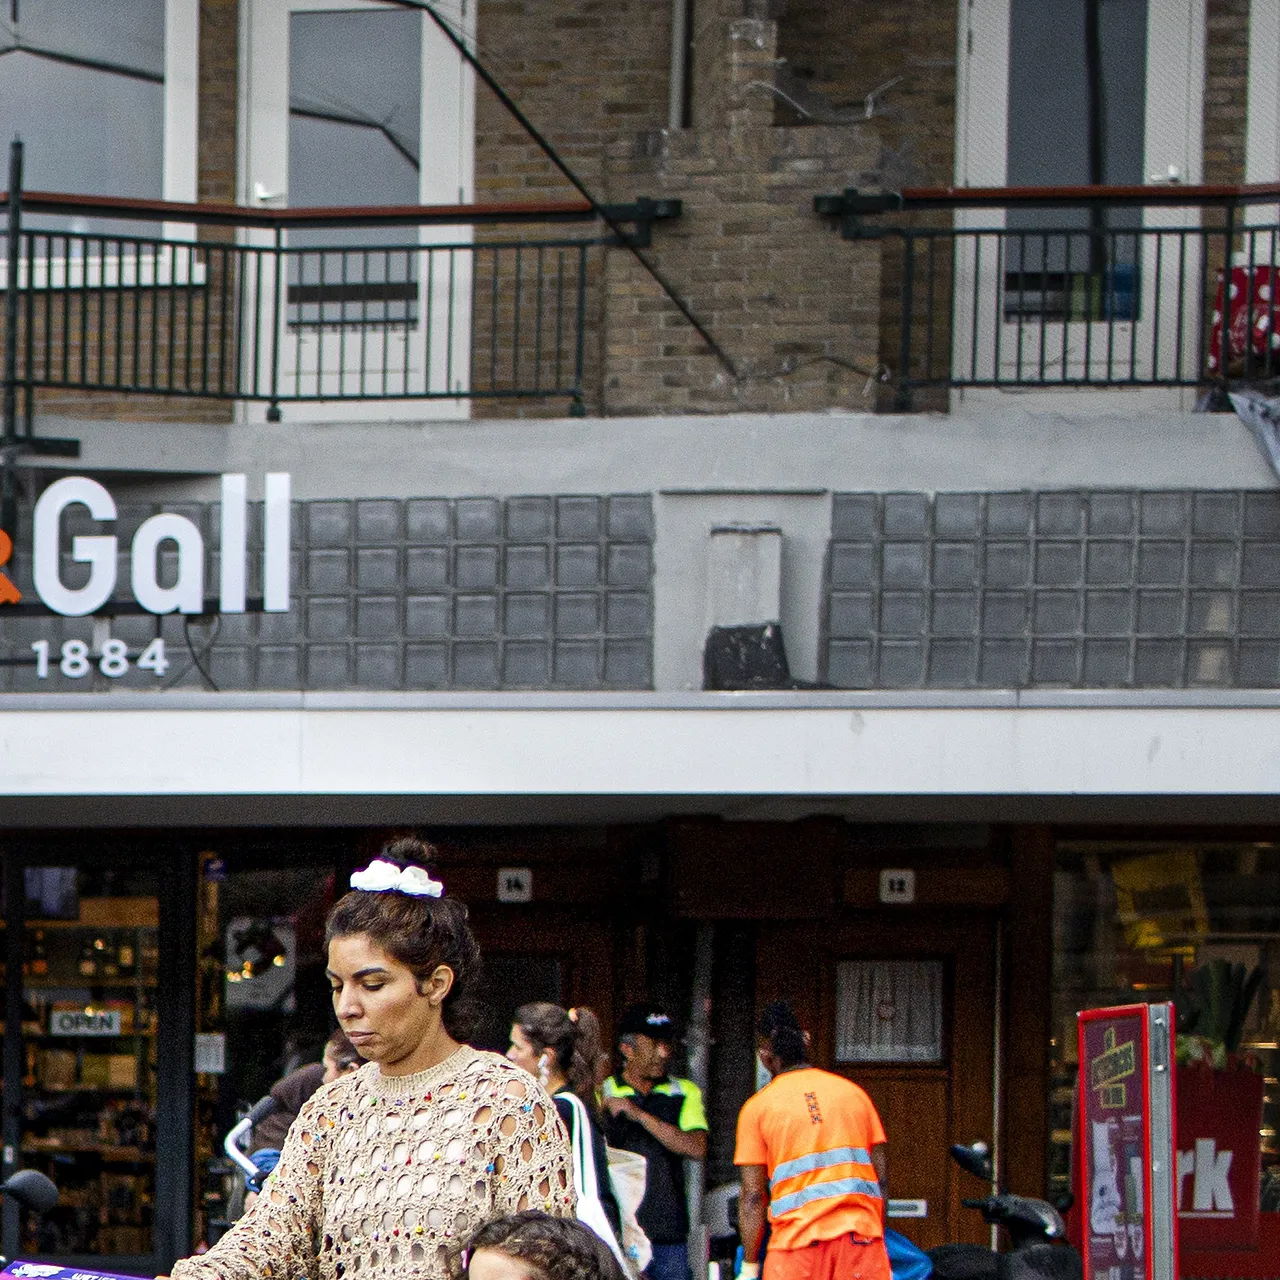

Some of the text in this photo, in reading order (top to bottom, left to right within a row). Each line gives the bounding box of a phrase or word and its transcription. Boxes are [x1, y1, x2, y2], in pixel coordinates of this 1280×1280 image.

[32, 472, 290, 617] Gall
[34, 638, 170, 680] 1884
[58, 1012, 114, 1031] OPEN
[1177, 1138, 1235, 1210] rk
